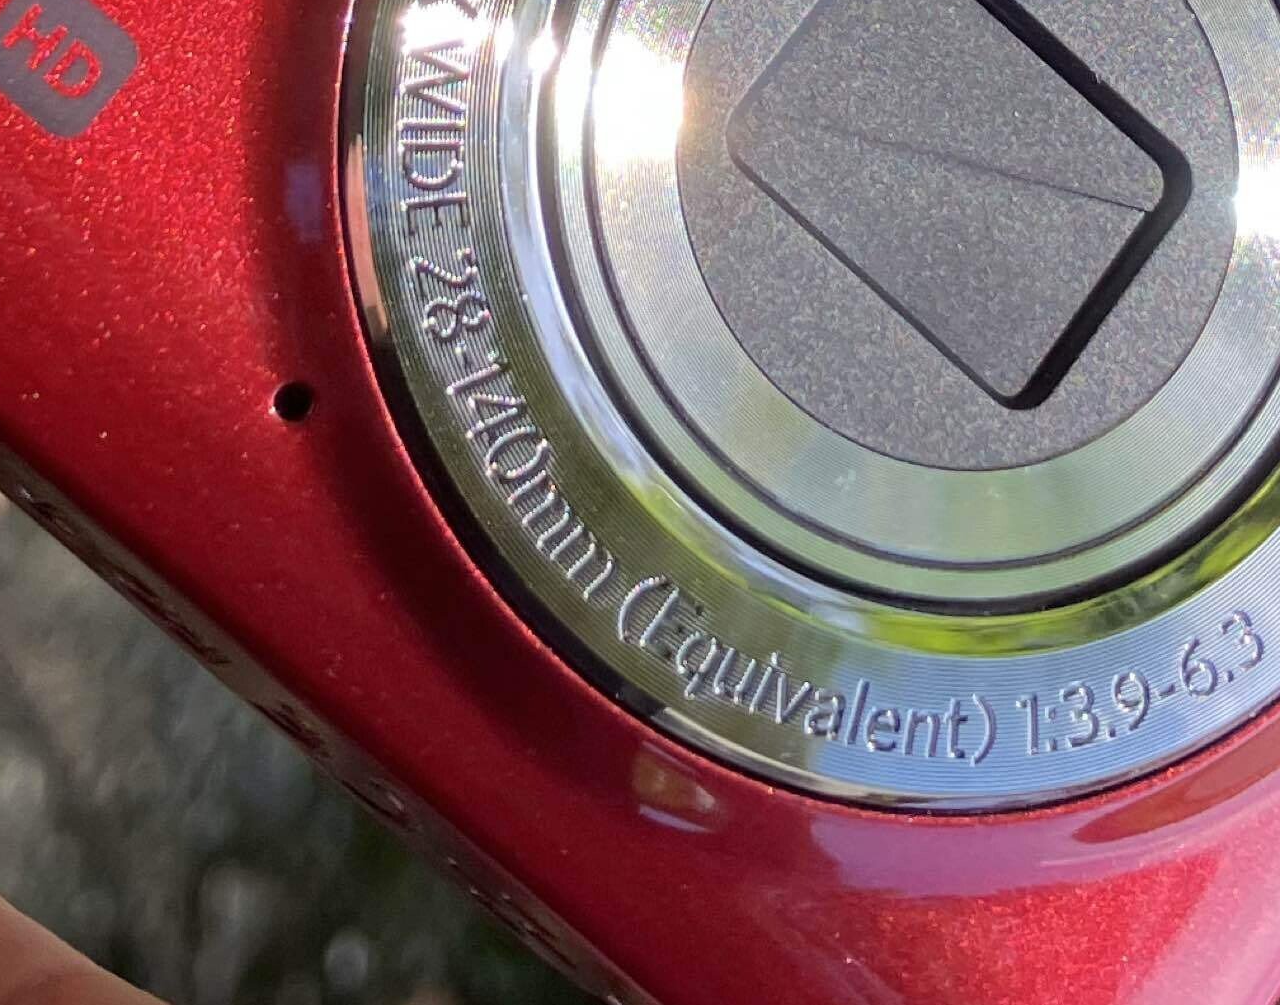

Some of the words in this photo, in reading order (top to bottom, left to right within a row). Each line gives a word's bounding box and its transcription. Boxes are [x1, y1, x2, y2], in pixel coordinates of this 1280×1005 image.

[1, 1, 104, 99] HD
[399, 32, 470, 236] WIDE
[408, 247, 616, 600] 28-140mm
[618, 575, 997, 766] (Equivalent)
[1016, 609, 1265, 756] 1:3.9-6.3
